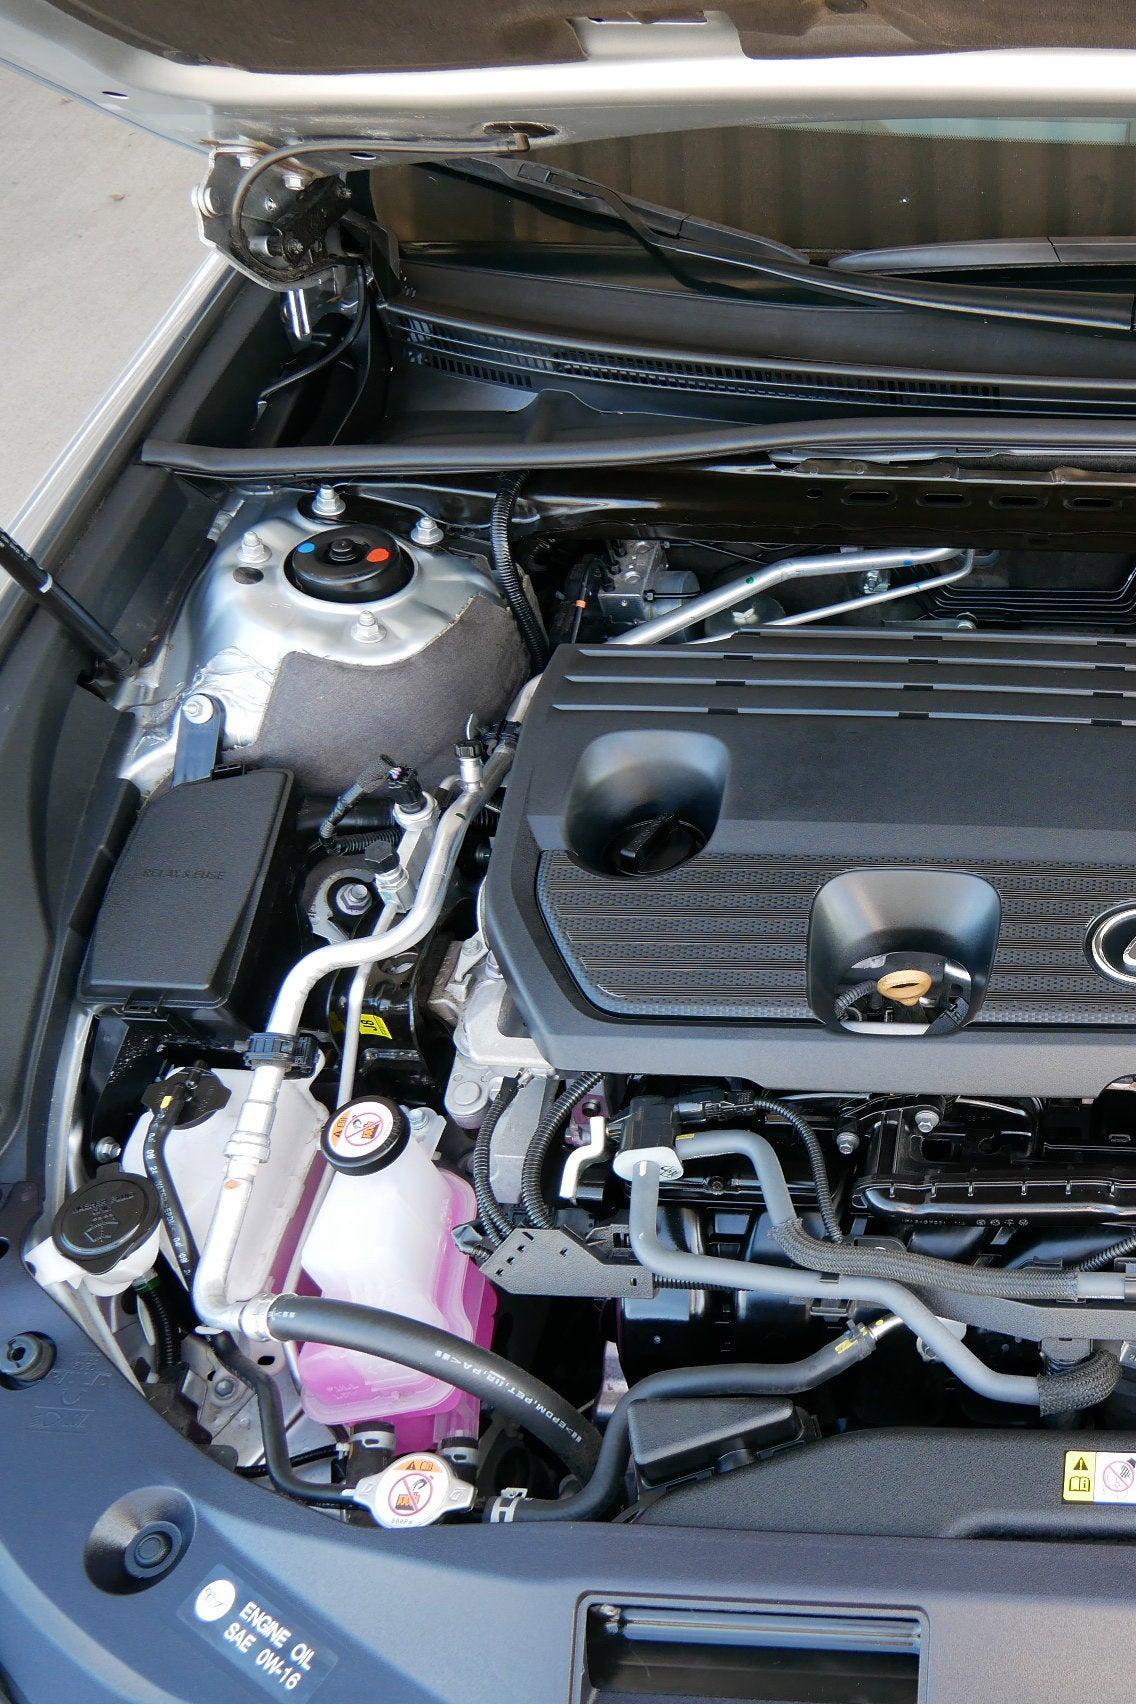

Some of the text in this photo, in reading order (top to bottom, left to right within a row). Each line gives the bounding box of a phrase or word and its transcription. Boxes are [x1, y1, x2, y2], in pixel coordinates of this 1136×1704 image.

[224, 1622, 302, 1690] SAE 0W-16
[240, 1601, 315, 1671] ENGINE OIL
